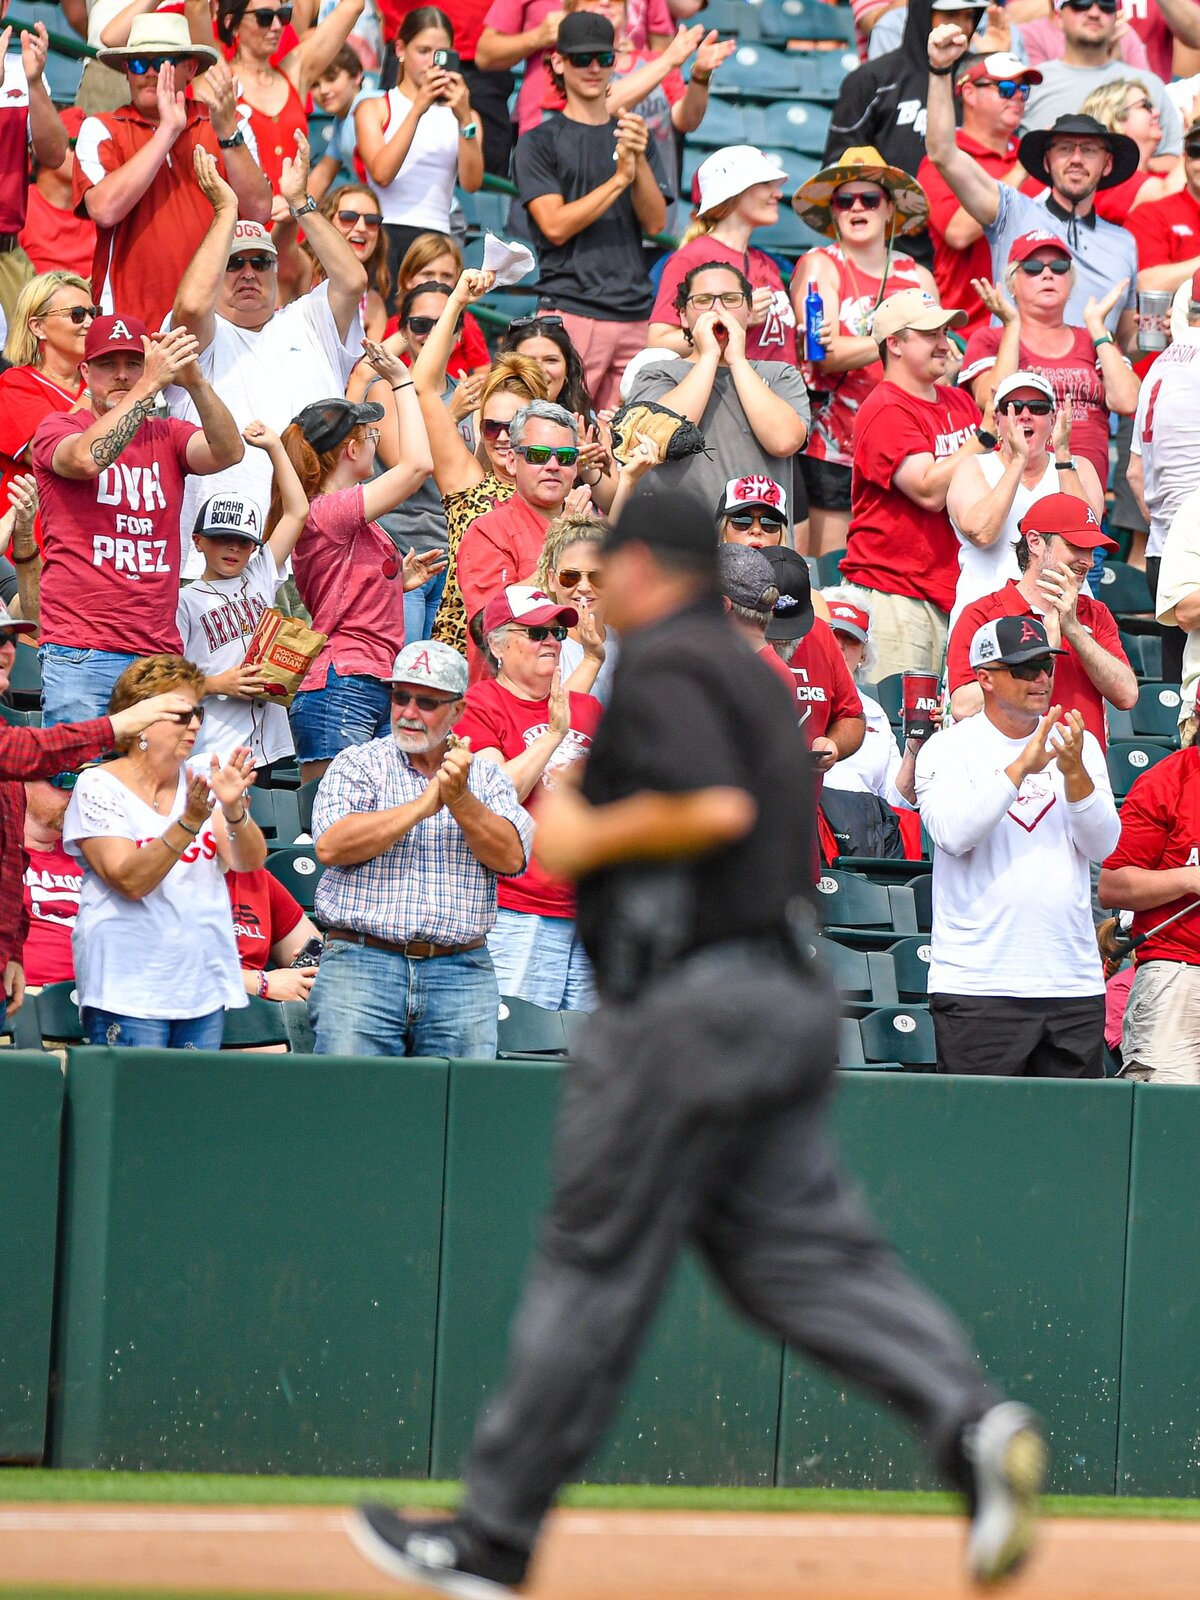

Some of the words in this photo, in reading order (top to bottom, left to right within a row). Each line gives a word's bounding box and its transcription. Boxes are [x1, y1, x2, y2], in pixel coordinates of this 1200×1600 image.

[234, 224, 262, 238] OGS
[108, 320, 133, 340] A
[758, 312, 784, 346] A
[97, 463, 166, 511] DVH
[213, 501, 244, 514] OMAHA
[1085, 507, 1099, 526] A
[116, 514, 154, 537] FOR
[211, 512, 241, 527] BOUND
[244, 510, 257, 531] A
[92, 535, 172, 573] PREZ
[1019, 621, 1043, 643] A
[408, 650, 431, 675] A
[1132, 755, 1146, 764] 18
[301, 861, 309, 871] 8
[821, 881, 833, 890] 12
[900, 1018, 908, 1028] 9
